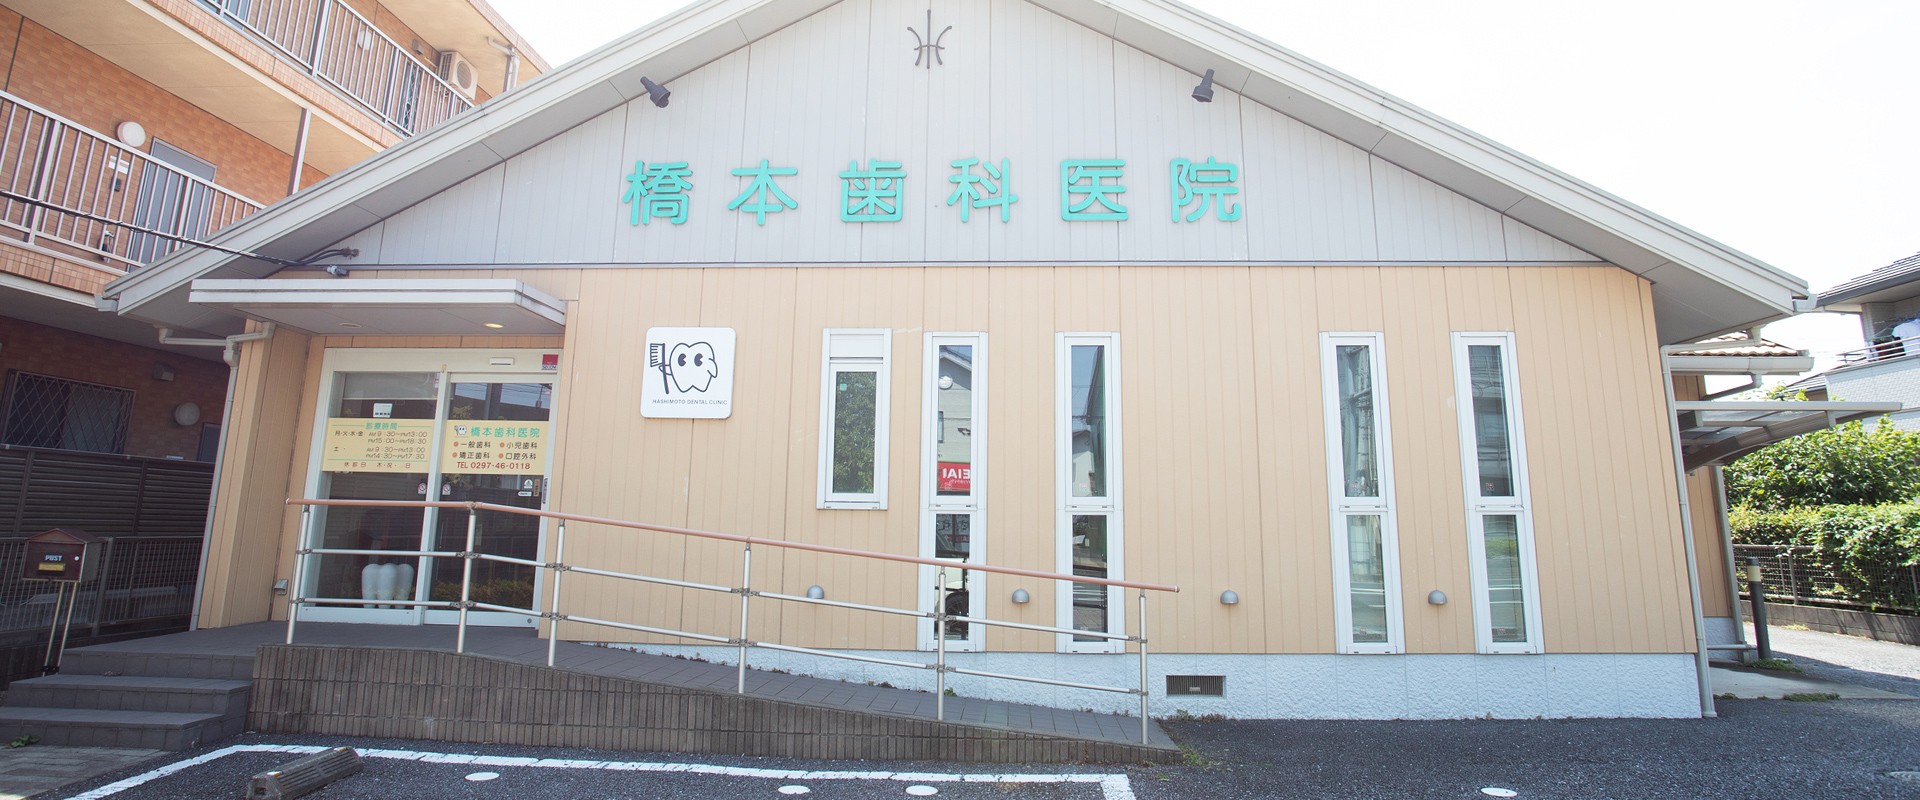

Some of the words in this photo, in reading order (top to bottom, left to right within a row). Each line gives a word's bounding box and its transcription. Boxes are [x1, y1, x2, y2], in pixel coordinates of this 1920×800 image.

[622, 156, 1242, 225] 橋本歯科医院
[471, 427, 540, 438] 橋本歯科医院
